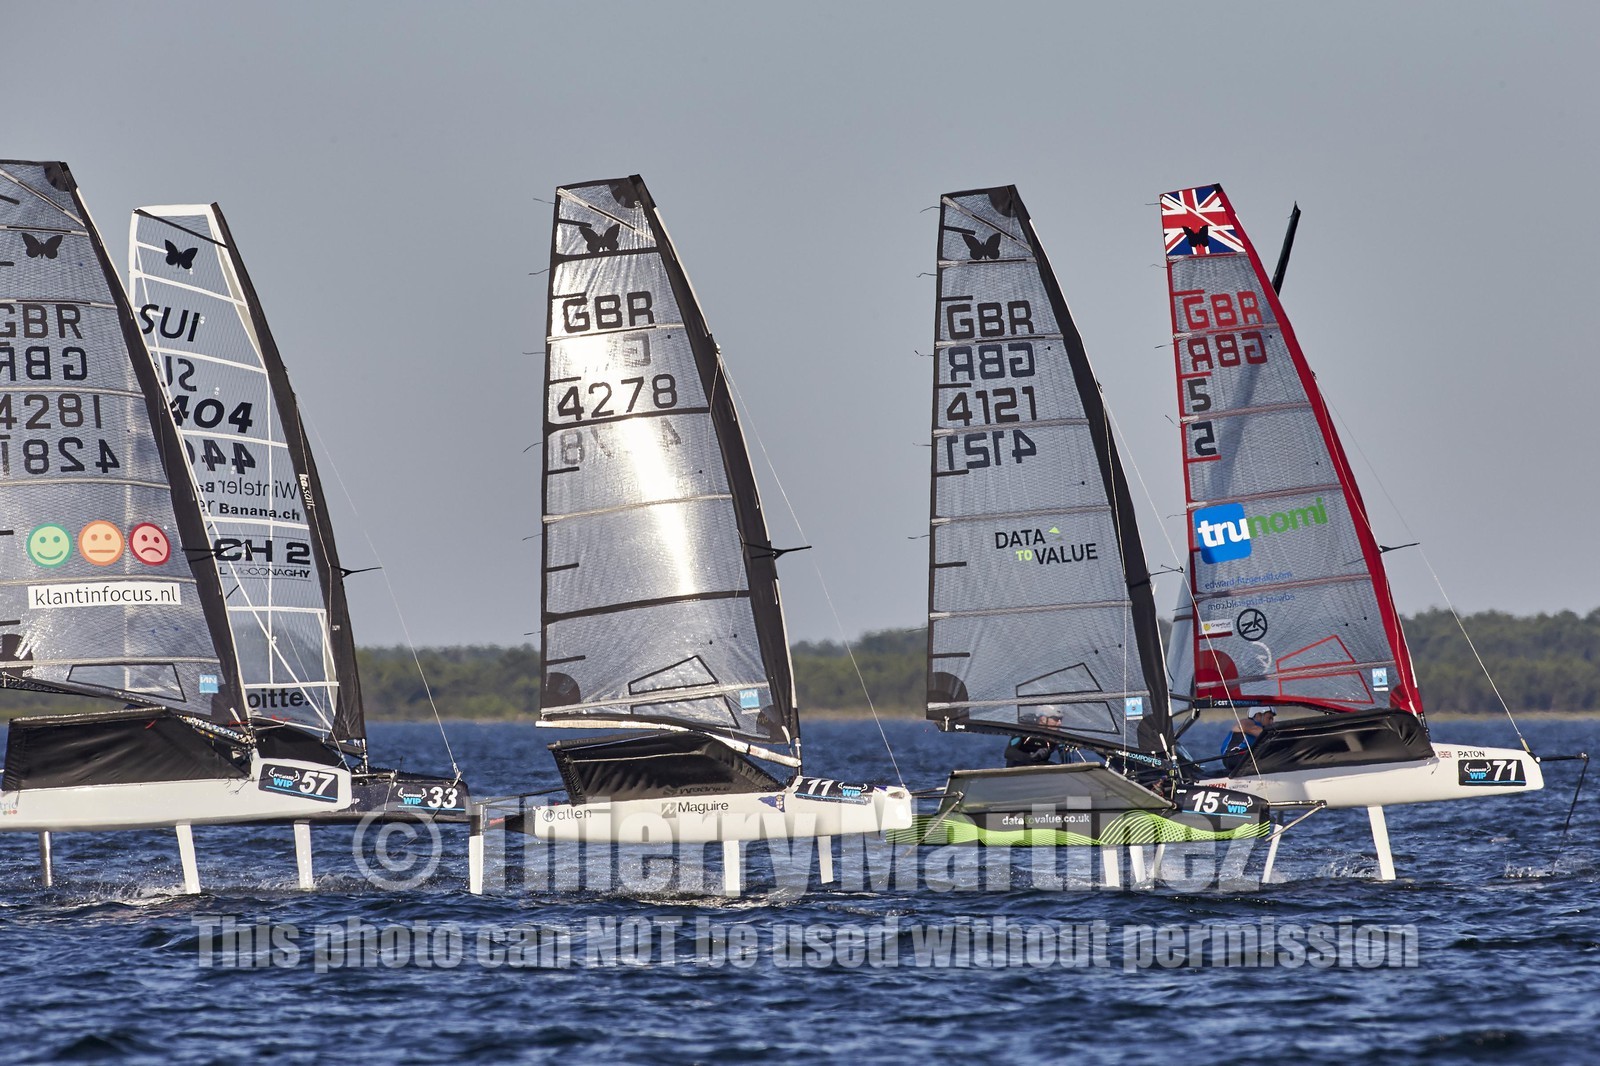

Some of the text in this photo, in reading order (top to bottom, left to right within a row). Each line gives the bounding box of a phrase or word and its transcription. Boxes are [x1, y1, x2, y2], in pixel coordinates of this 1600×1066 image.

[0, 303, 83, 339] GBR
[139, 303, 200, 342] SUI
[562, 291, 655, 333] GBR
[946, 300, 1034, 340] GBR
[1182, 290, 1262, 330] GBR
[557, 373, 678, 421] 4278
[946, 385, 1037, 426] 4121
[1186, 378, 1212, 412] 5
[0, 393, 101, 430] 4281
[218, 503, 300, 521] Banana.ch
[1197, 496, 1329, 548] trunomi
[994, 528, 1046, 549] DATA
[286, 541, 311, 566] 2
[1015, 543, 1098, 565] TO VALUE
[35, 586, 177, 606] klantinfocus.nl
[1457, 750, 1485, 758] PATON
[1469, 760, 1518, 781] WIP 71
[273, 771, 336, 796] WIP 57
[807, 778, 861, 798] 11 WIP
[403, 786, 458, 809] WIP 33
[677, 800, 729, 815] Maguire
[1192, 790, 1248, 814] 15 WIP
[557, 808, 592, 820] allen
